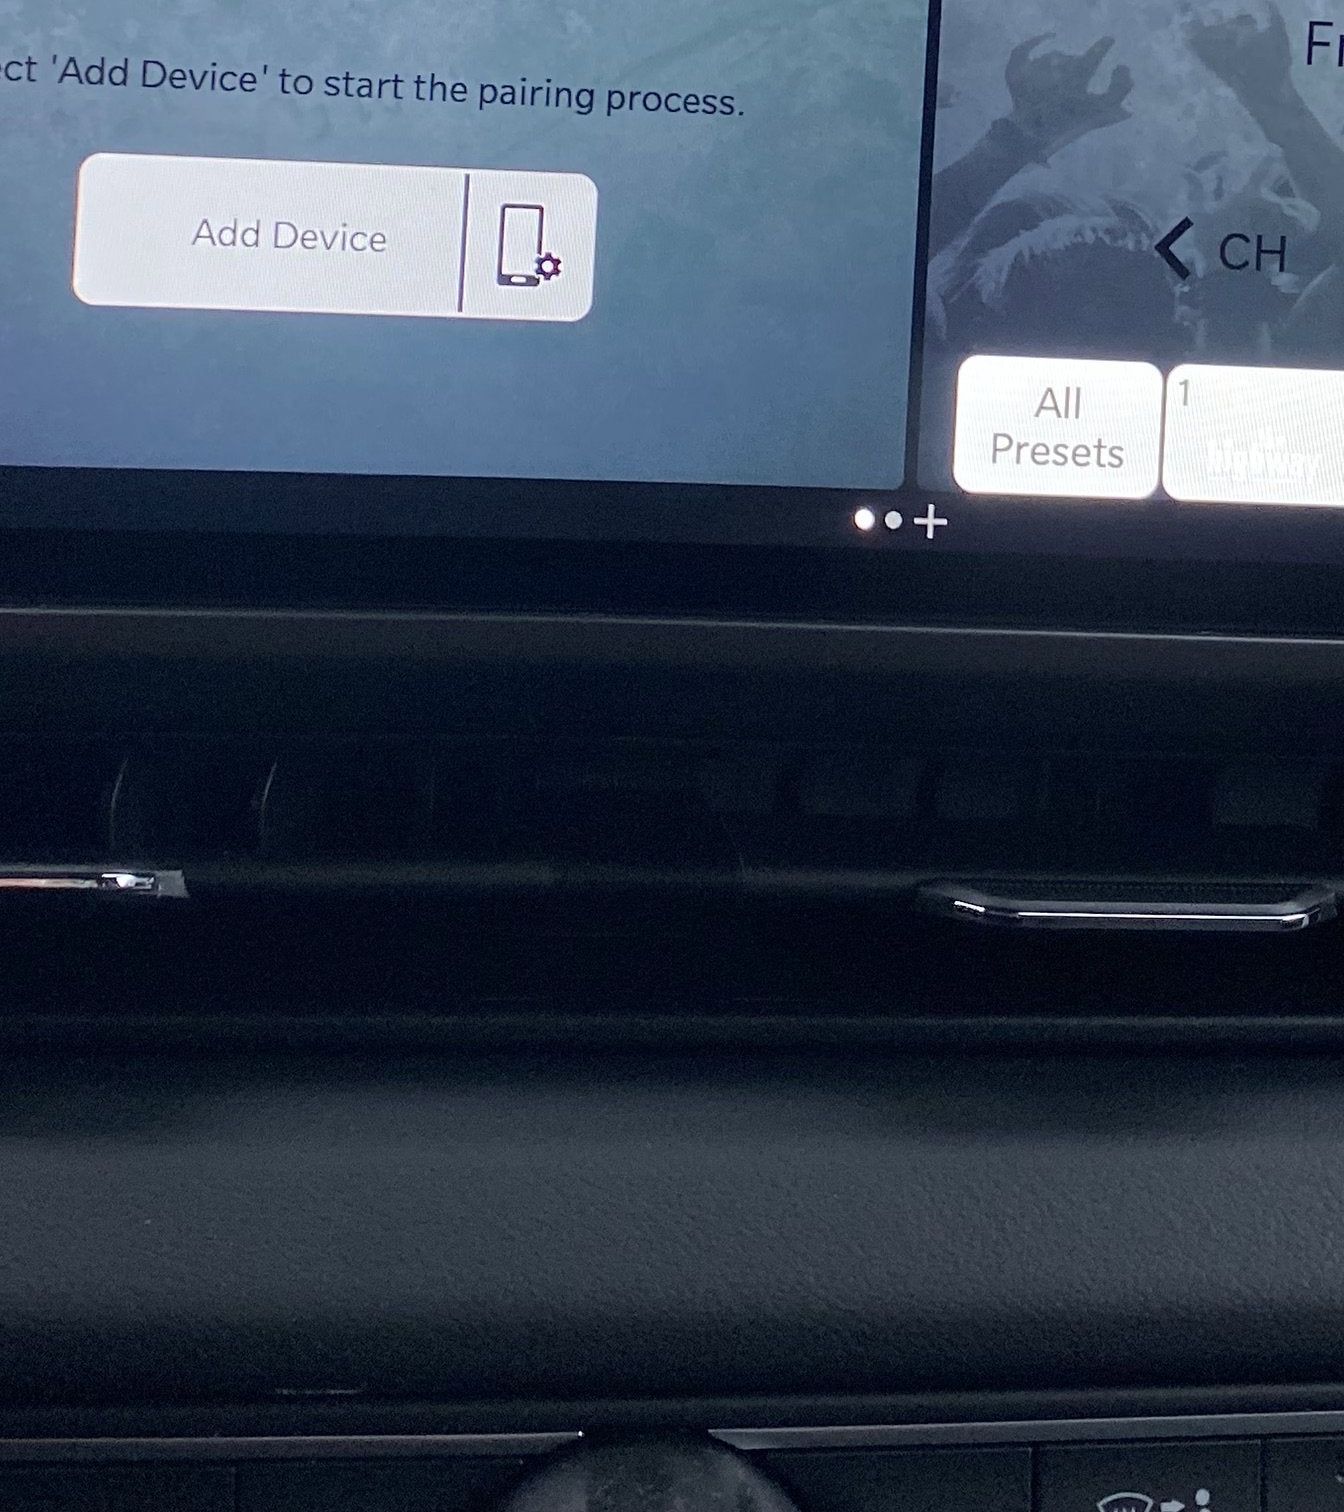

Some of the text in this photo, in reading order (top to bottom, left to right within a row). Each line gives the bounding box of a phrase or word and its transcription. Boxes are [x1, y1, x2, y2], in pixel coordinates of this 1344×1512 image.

[52, 54, 129, 87] 'Add
[141, 59, 268, 93] Device'
[278, 67, 314, 96] to
[324, 71, 404, 101] start
[414, 73, 468, 103] the
[478, 77, 595, 116] pairing
[606, 88, 745, 117] process.
[192, 217, 387, 253] Add Device
[1218, 233, 1287, 272] CH
[1034, 386, 1082, 420] All
[1178, 379, 1190, 407] 1
[991, 433, 1125, 469] Presets
